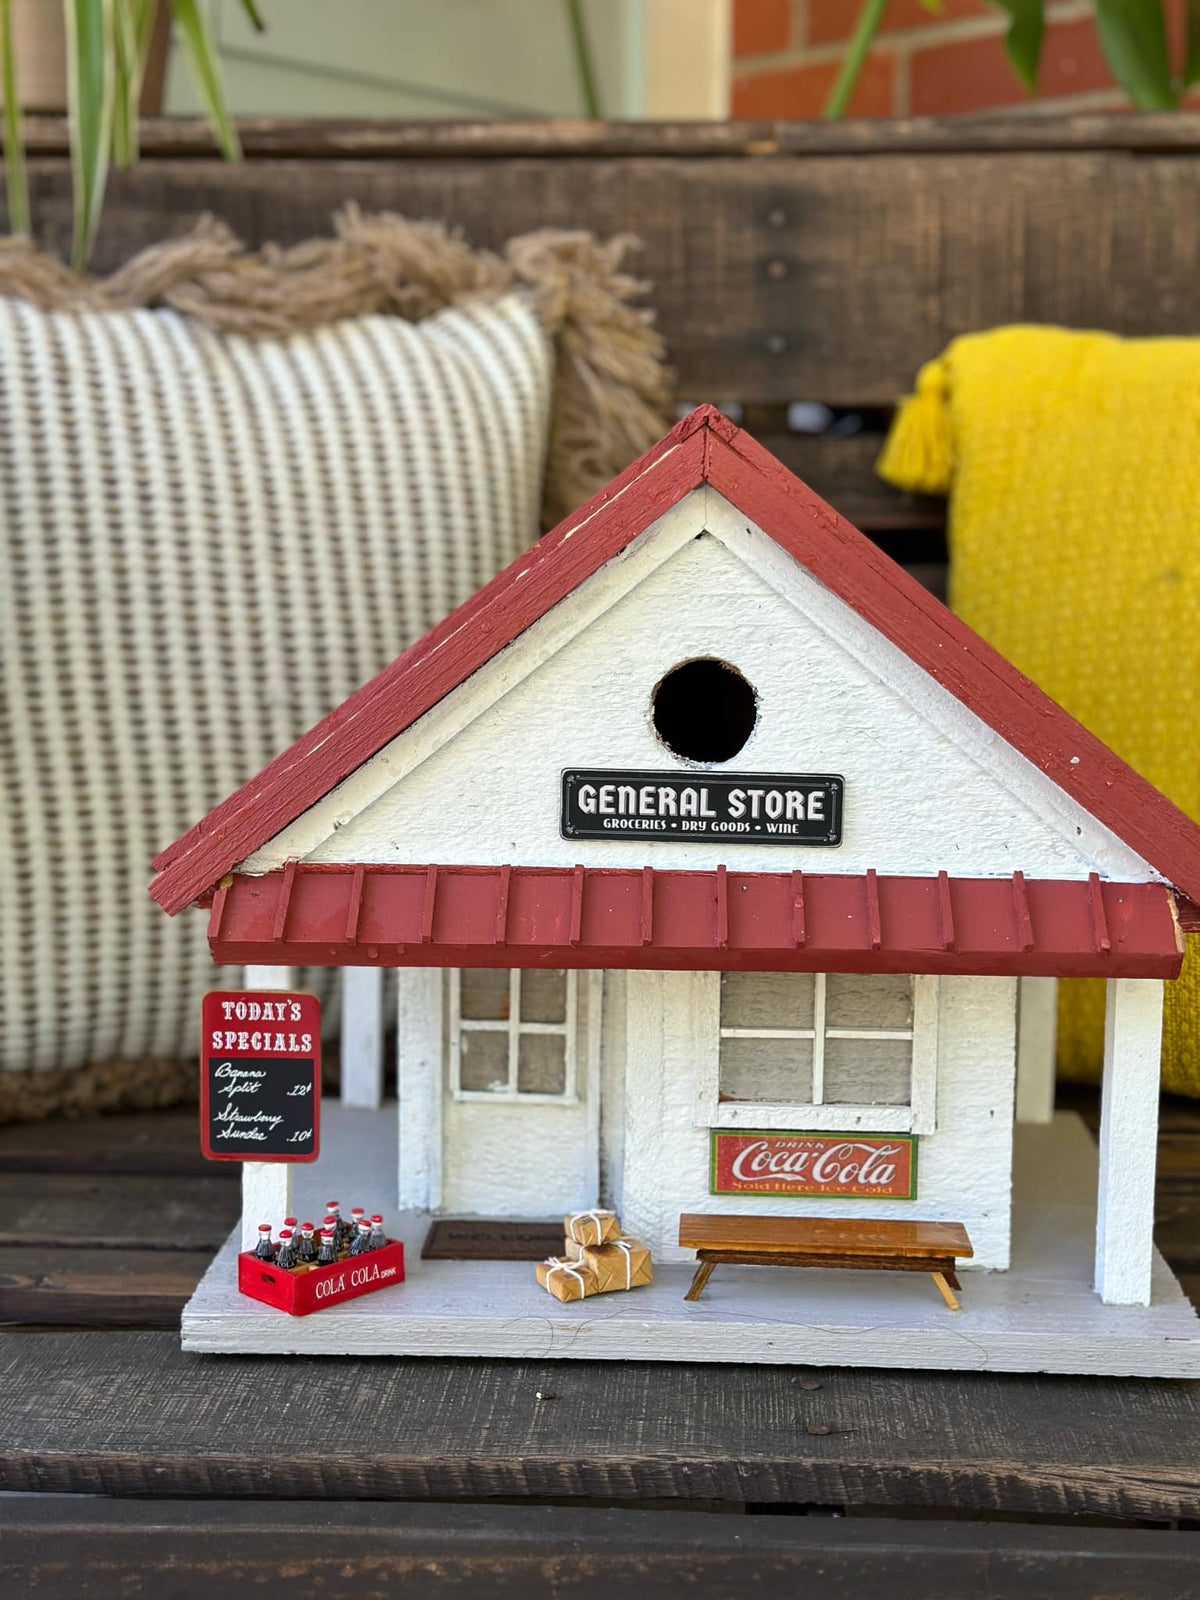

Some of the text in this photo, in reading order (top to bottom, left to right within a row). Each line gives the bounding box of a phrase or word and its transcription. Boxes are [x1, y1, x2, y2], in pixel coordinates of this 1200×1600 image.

[578, 784, 826, 821] GENERAL STORE
[603, 818, 800, 834] GROCERIES DRY GOODS WINE
[222, 1000, 302, 1021] TODAY'S
[212, 1031, 312, 1052] SPECIALS
[215, 1063, 266, 1078] Banana
[218, 1078, 262, 1098] Split
[213, 1103, 284, 1130] Strawberry
[775, 1140, 825, 1149] DRINK
[732, 1141, 903, 1185] Coca-Cola
[732, 1182, 893, 1194] Sold Here Ice Cold
[351, 1264, 380, 1287] COLA
[380, 1267, 397, 1279] DRINK
